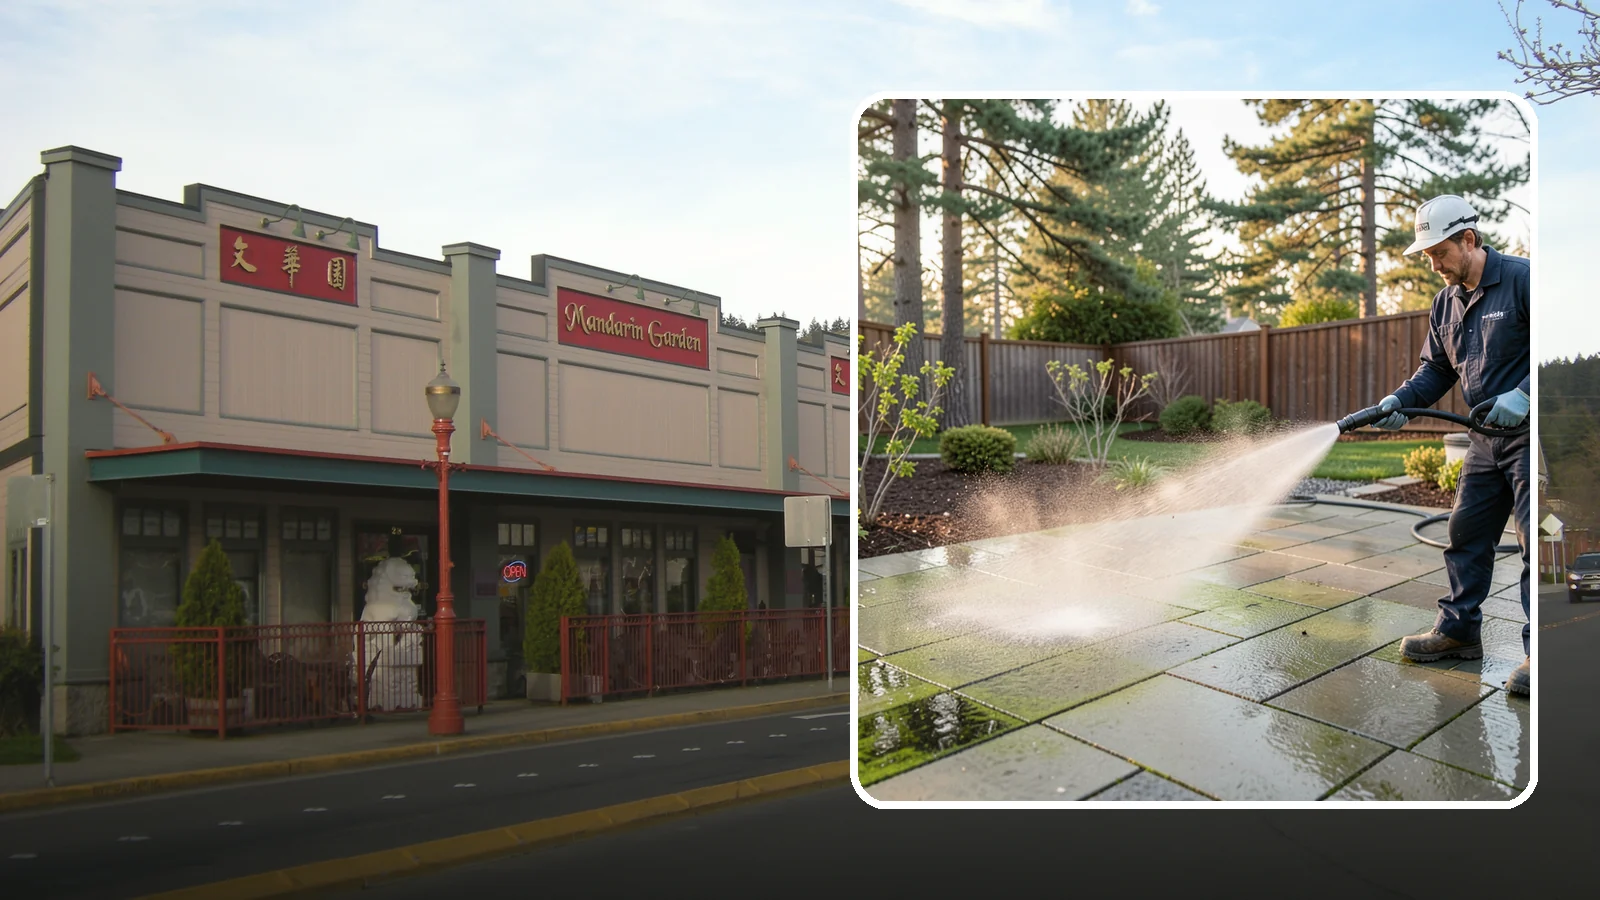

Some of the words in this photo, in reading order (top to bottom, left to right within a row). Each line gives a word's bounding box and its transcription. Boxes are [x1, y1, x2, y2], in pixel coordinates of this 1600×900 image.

[230, 235, 346, 291] 文華園
[564, 302, 644, 341] Mandarin
[648, 320, 701, 352] Garden
[835, 363, 846, 386] 文
[503, 565, 527, 578] OPEN
